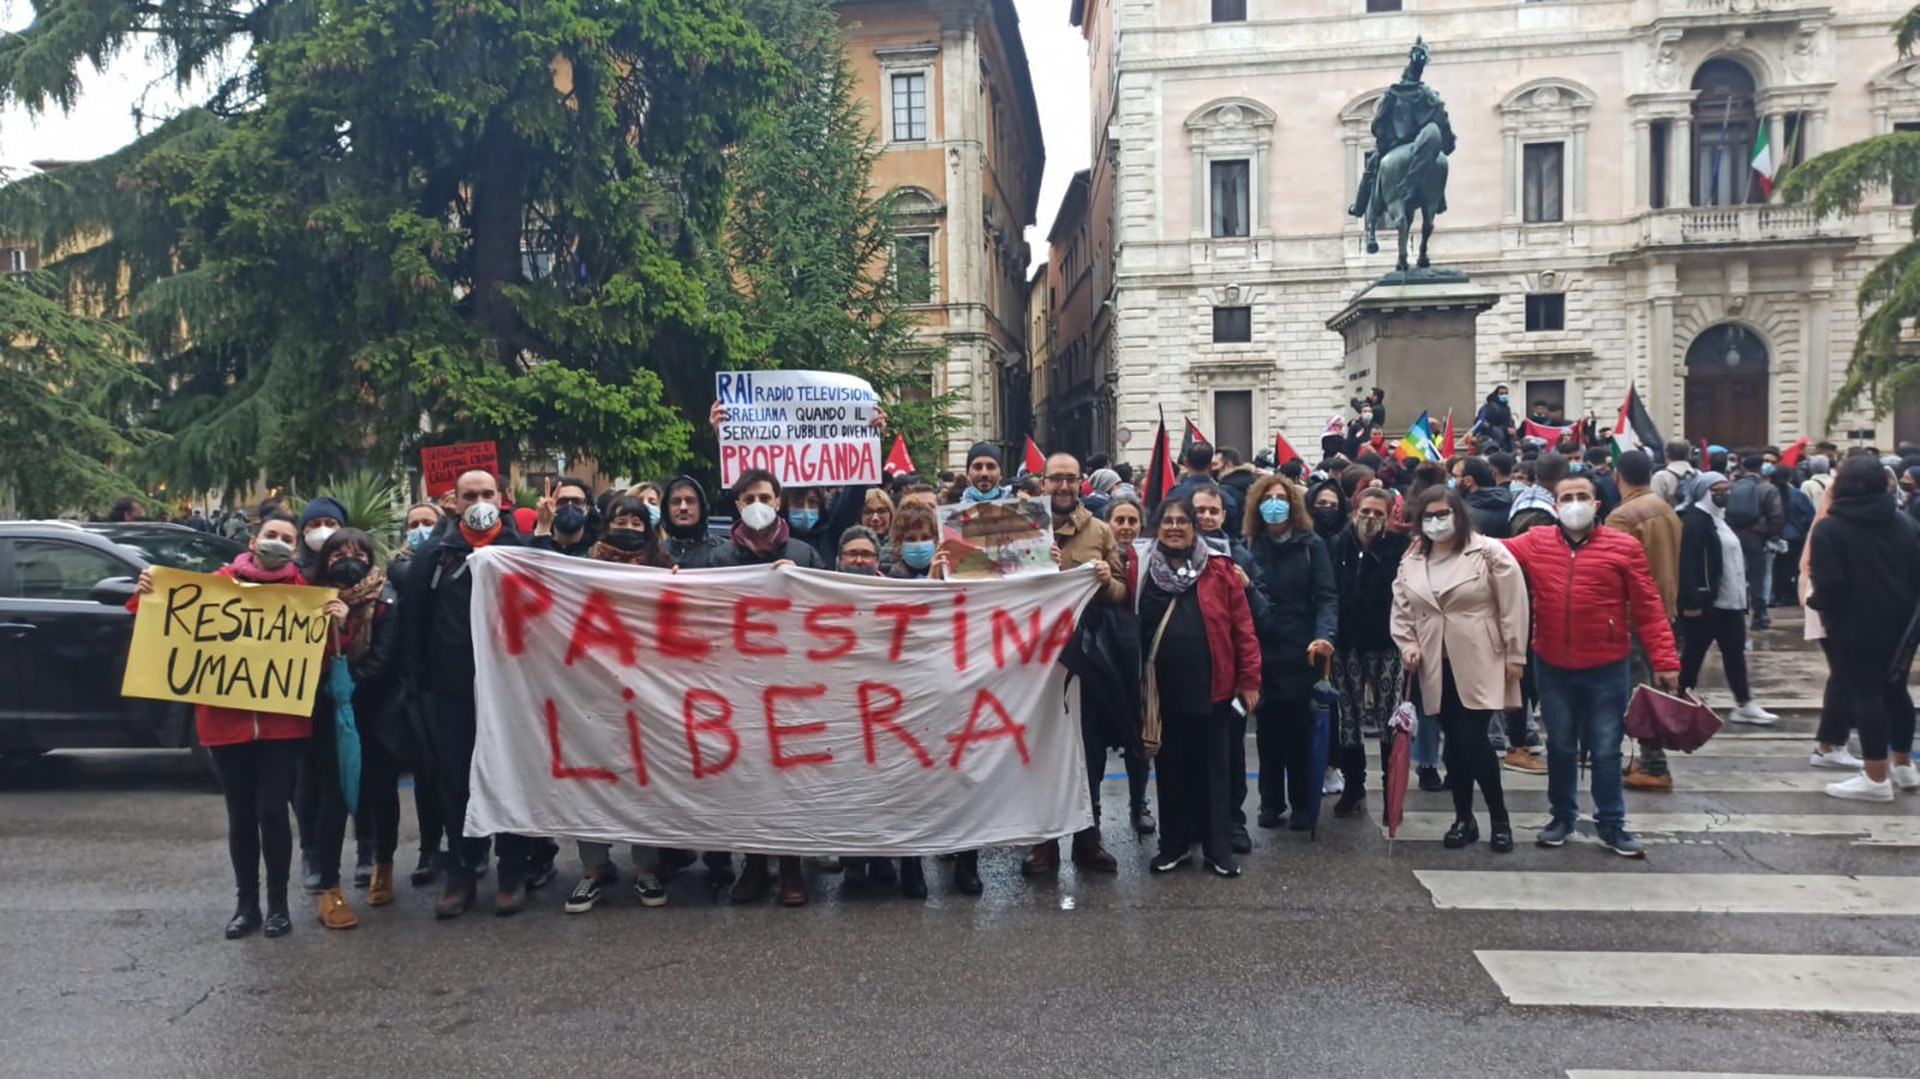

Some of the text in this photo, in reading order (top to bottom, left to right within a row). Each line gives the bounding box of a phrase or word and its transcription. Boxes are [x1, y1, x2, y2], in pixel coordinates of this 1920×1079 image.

[755, 385, 794, 402] RADIO
[725, 406, 867, 422] SRAELIANA QUANDO IL
[723, 424, 880, 440] SERVIZIO PUBBLICO DIVENTA
[722, 443, 876, 485] PROPAGANDA
[167, 647, 308, 701] UMANI
